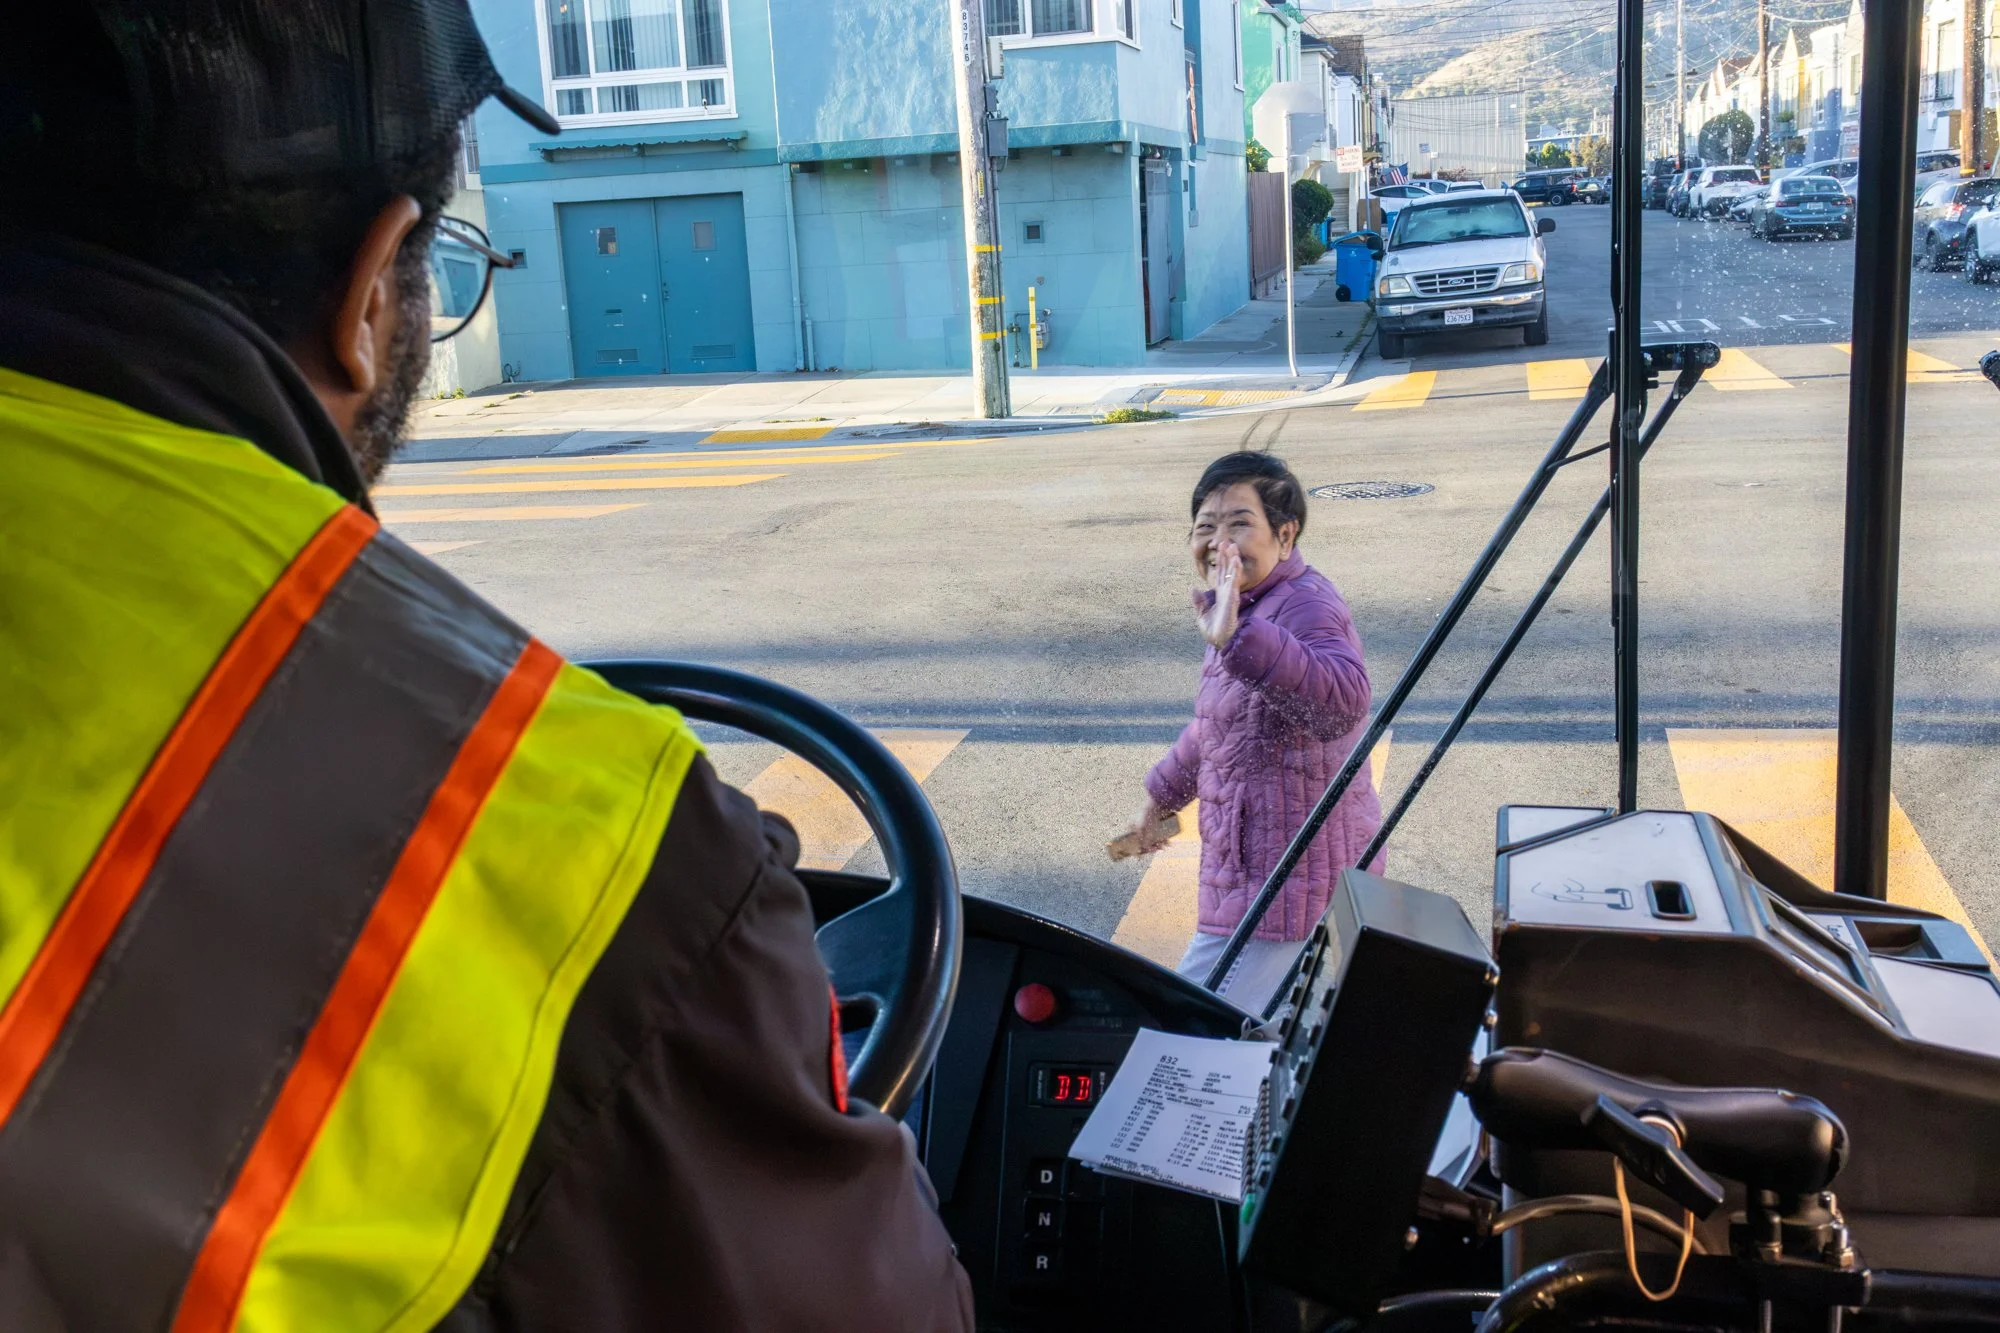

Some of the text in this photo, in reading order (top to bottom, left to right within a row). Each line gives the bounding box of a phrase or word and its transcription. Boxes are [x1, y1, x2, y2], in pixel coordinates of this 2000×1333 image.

[962, 12, 970, 62] 83746
[1160, 1055, 1178, 1064] 832
[1040, 1170, 1053, 1183] D
[1038, 1212, 1051, 1226] N
[1036, 1255, 1048, 1269] R
